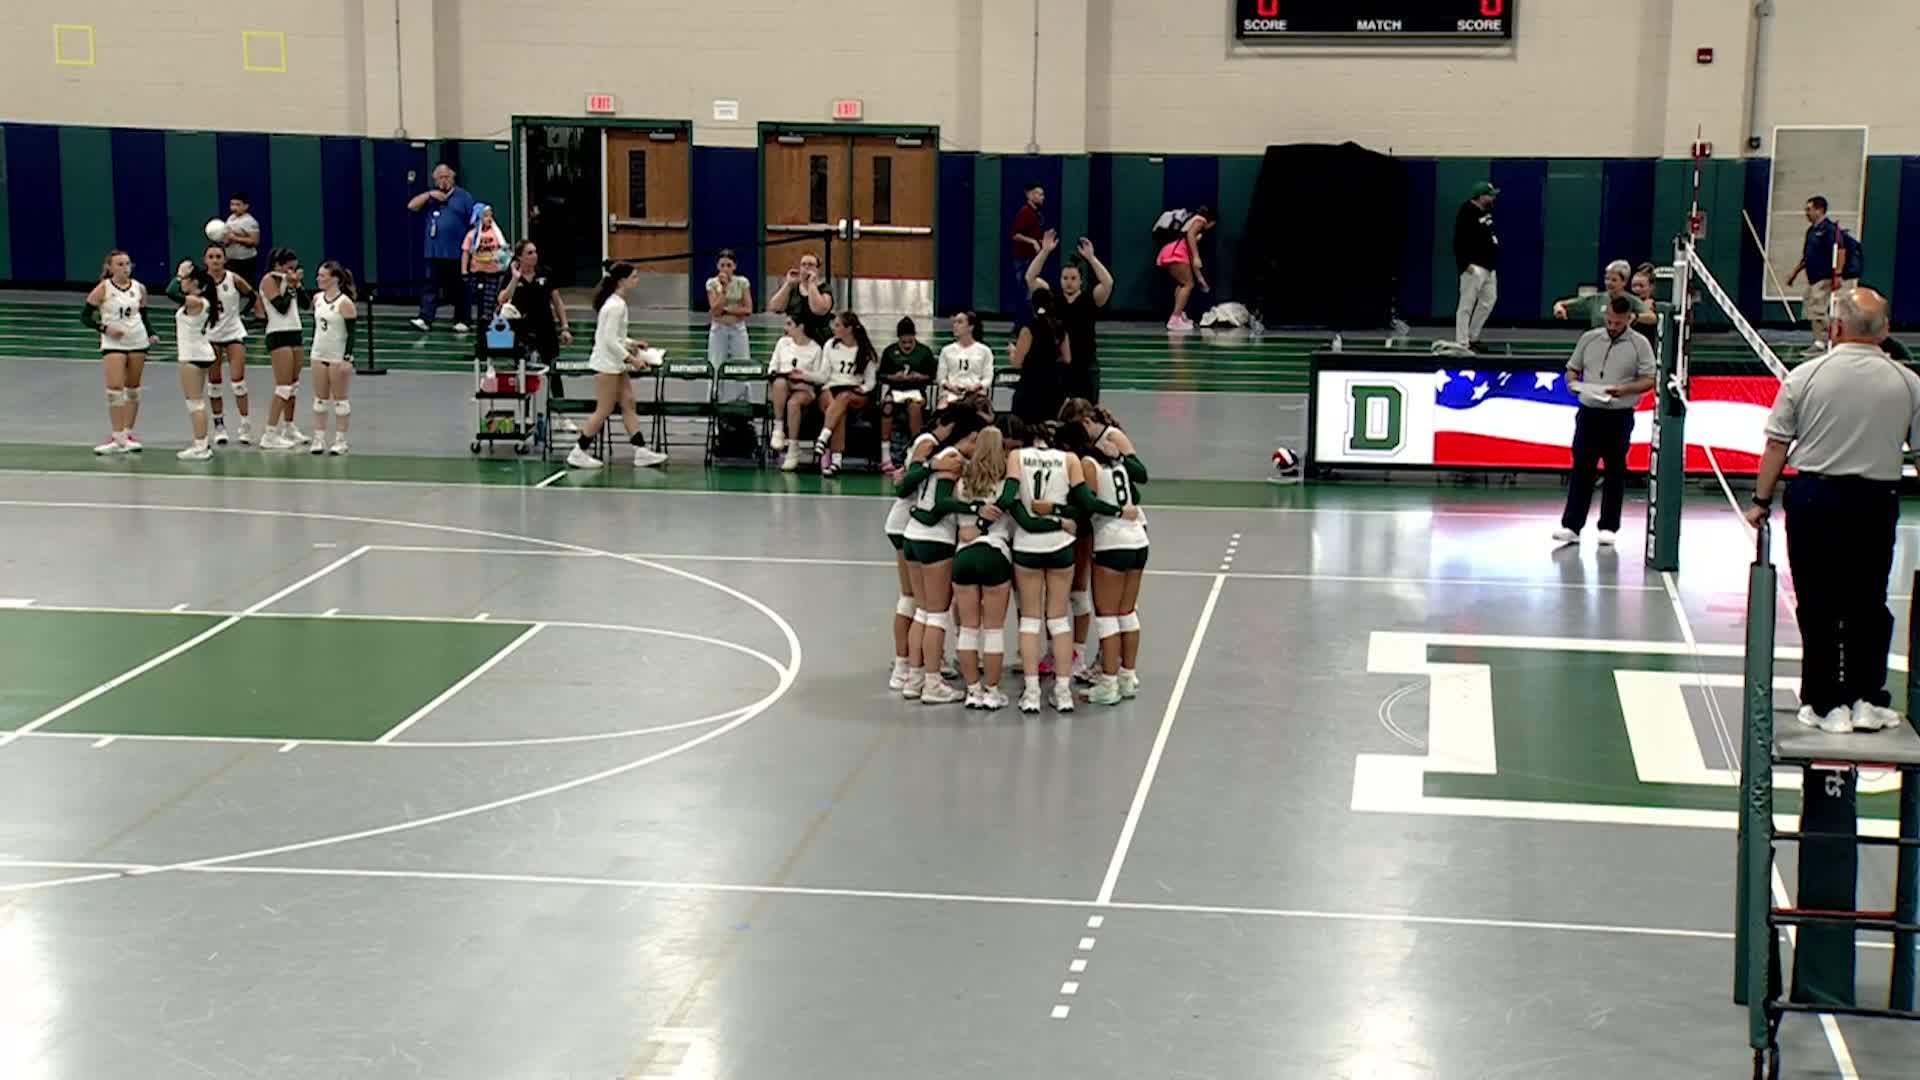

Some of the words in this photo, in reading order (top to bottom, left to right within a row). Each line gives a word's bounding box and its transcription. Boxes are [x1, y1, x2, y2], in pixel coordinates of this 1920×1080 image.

[1243, 19, 1288, 30] SCORE
[1356, 20, 1402, 31] MATCH
[1456, 19, 1502, 30] SCORE
[592, 96, 610, 109] EXIT
[838, 103, 857, 115] EXIT
[1347, 382, 1405, 453] D
